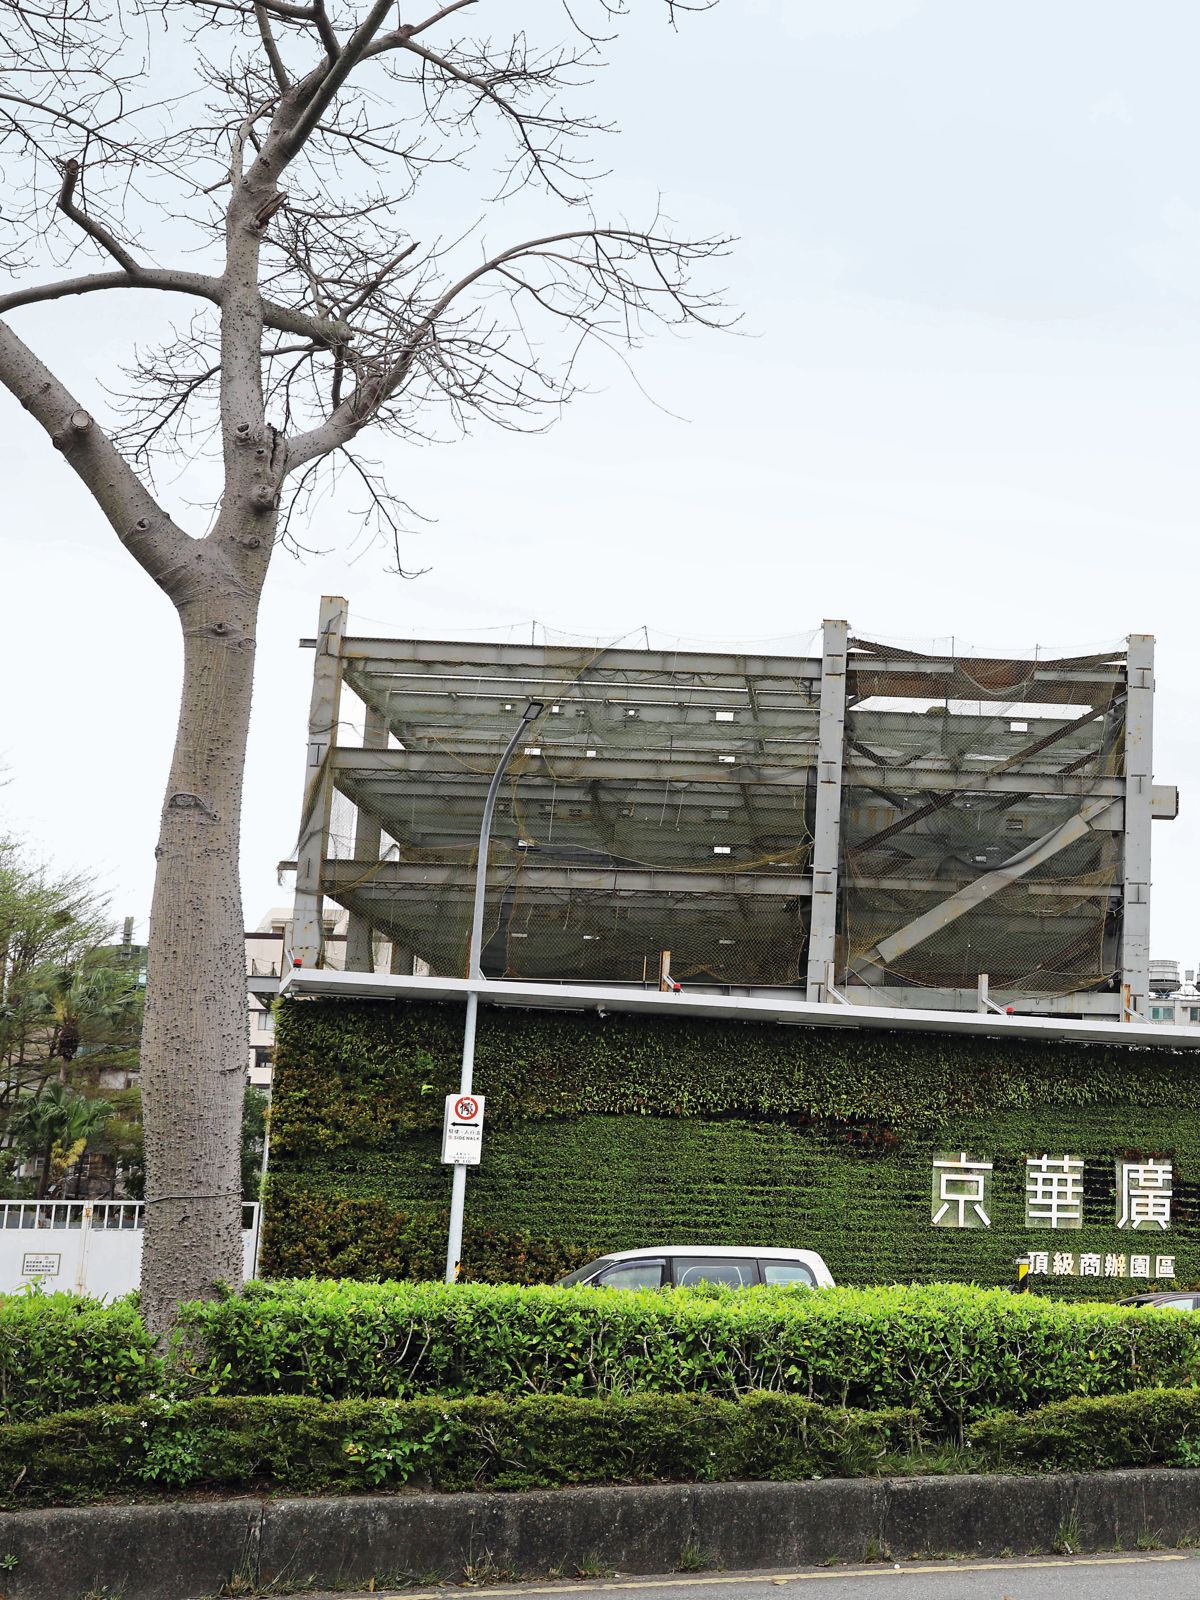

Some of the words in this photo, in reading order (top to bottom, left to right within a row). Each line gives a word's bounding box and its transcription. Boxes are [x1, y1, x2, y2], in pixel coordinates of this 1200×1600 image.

[1028, 1252, 1176, 1278] 頂級商辦園區
